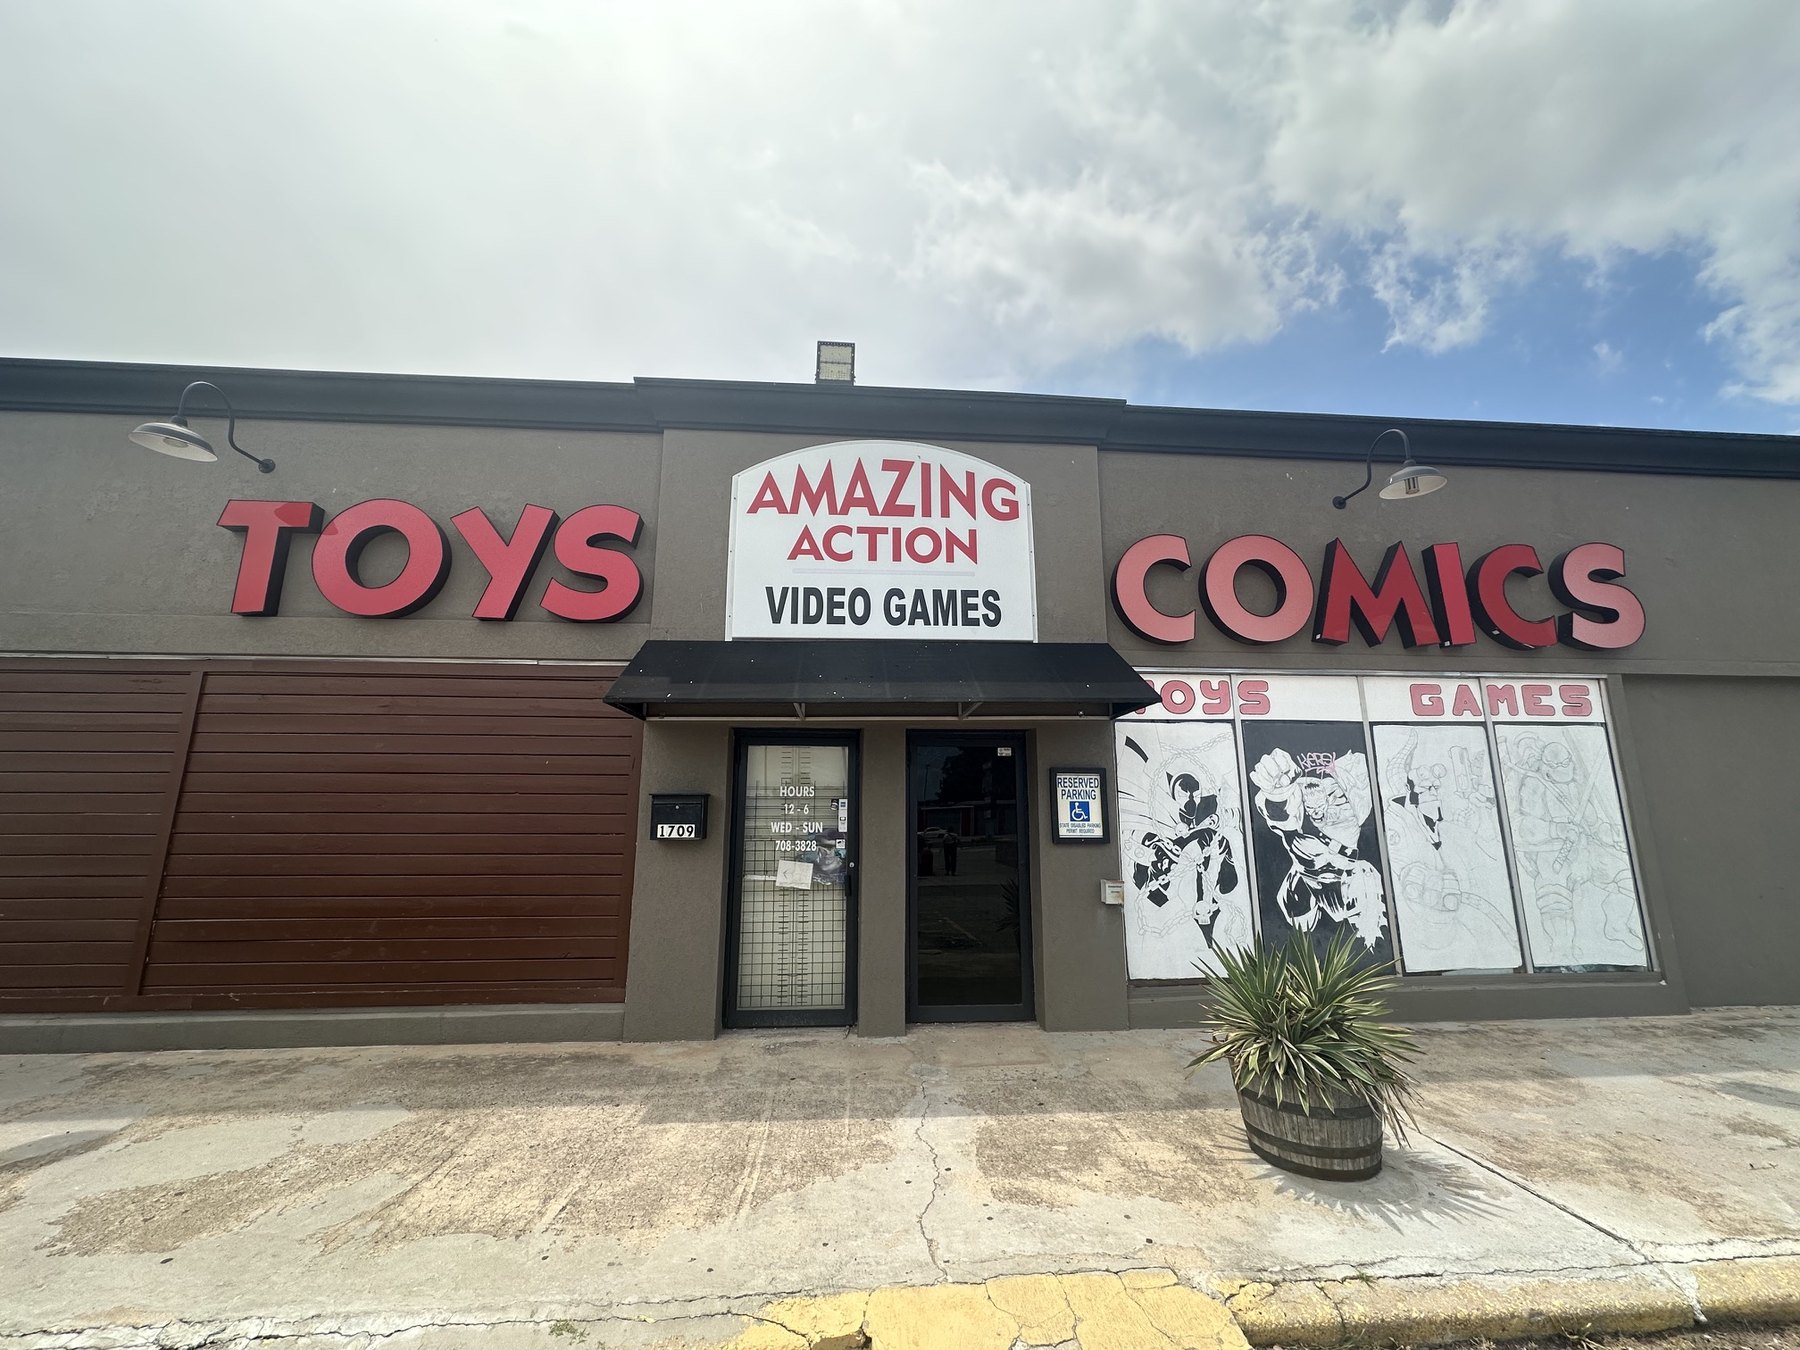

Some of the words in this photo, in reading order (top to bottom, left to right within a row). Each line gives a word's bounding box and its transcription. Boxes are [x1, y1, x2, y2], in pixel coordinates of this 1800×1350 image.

[747, 457, 1020, 522] AMAZING
[787, 524, 978, 564] ACTION
[216, 498, 644, 622] TOYS
[1110, 533, 1646, 650] COMICS
[765, 586, 871, 625] VIDEO
[883, 587, 1001, 627] GAMES
[1134, 680, 1270, 715] OYS
[1409, 683, 1592, 717] GAMES
[780, 786, 815, 797] HOURS
[1057, 777, 1100, 788] RESERVED
[1061, 789, 1096, 800] PARKING
[784, 804, 795, 815] 12
[803, 804, 809, 815] 6
[659, 825, 694, 837] 1709
[771, 822, 792, 833] WED
[802, 822, 823, 833] SUN
[775, 840, 817, 852] 708-3828
